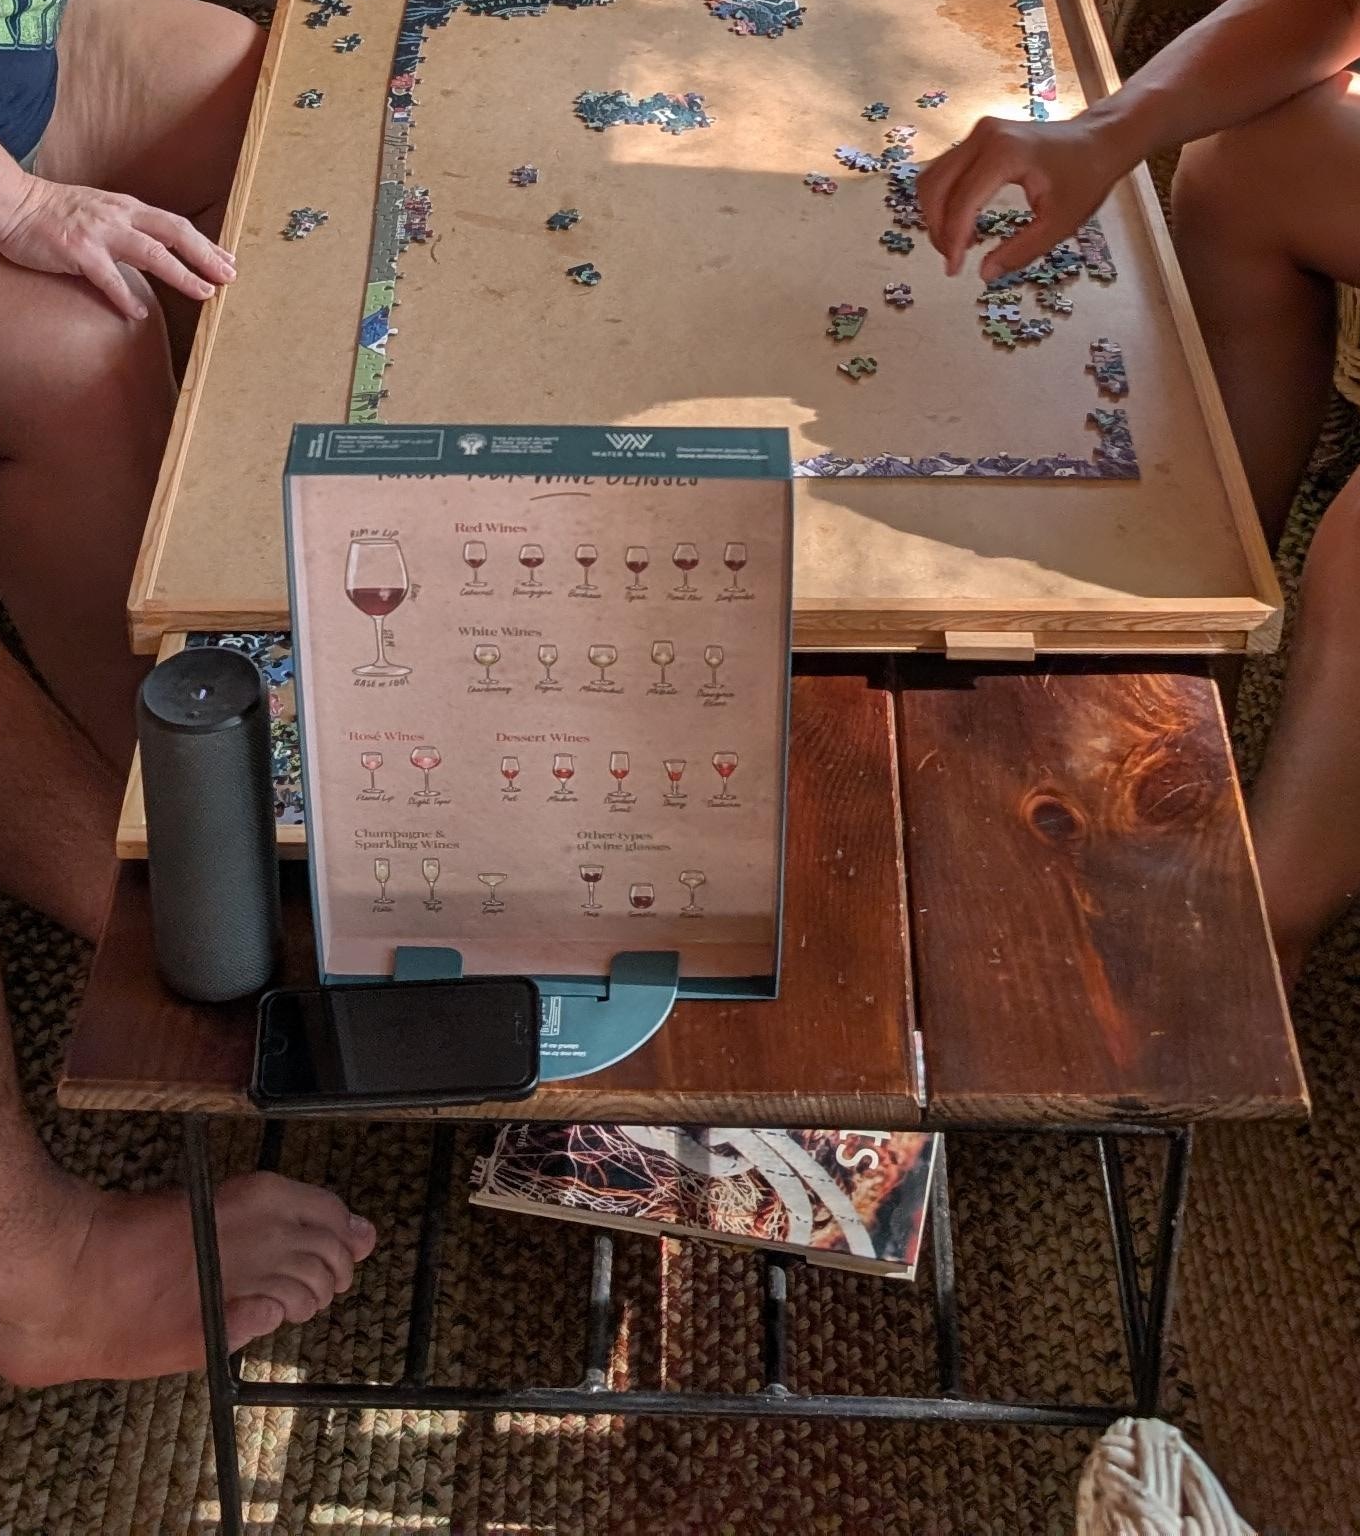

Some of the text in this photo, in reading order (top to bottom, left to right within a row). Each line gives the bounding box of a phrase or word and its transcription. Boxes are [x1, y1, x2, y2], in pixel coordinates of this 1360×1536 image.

[454, 521, 528, 534] Red Wines
[457, 626, 543, 638] White Wines
[347, 730, 425, 742] Rosé Wines
[495, 732, 591, 744] Dessert Wines
[354, 828, 446, 841] Champagne &
[576, 830, 654, 843] Other types
[354, 839, 461, 851] Sparkling Wines
[576, 841, 672, 853] of wine glasses
